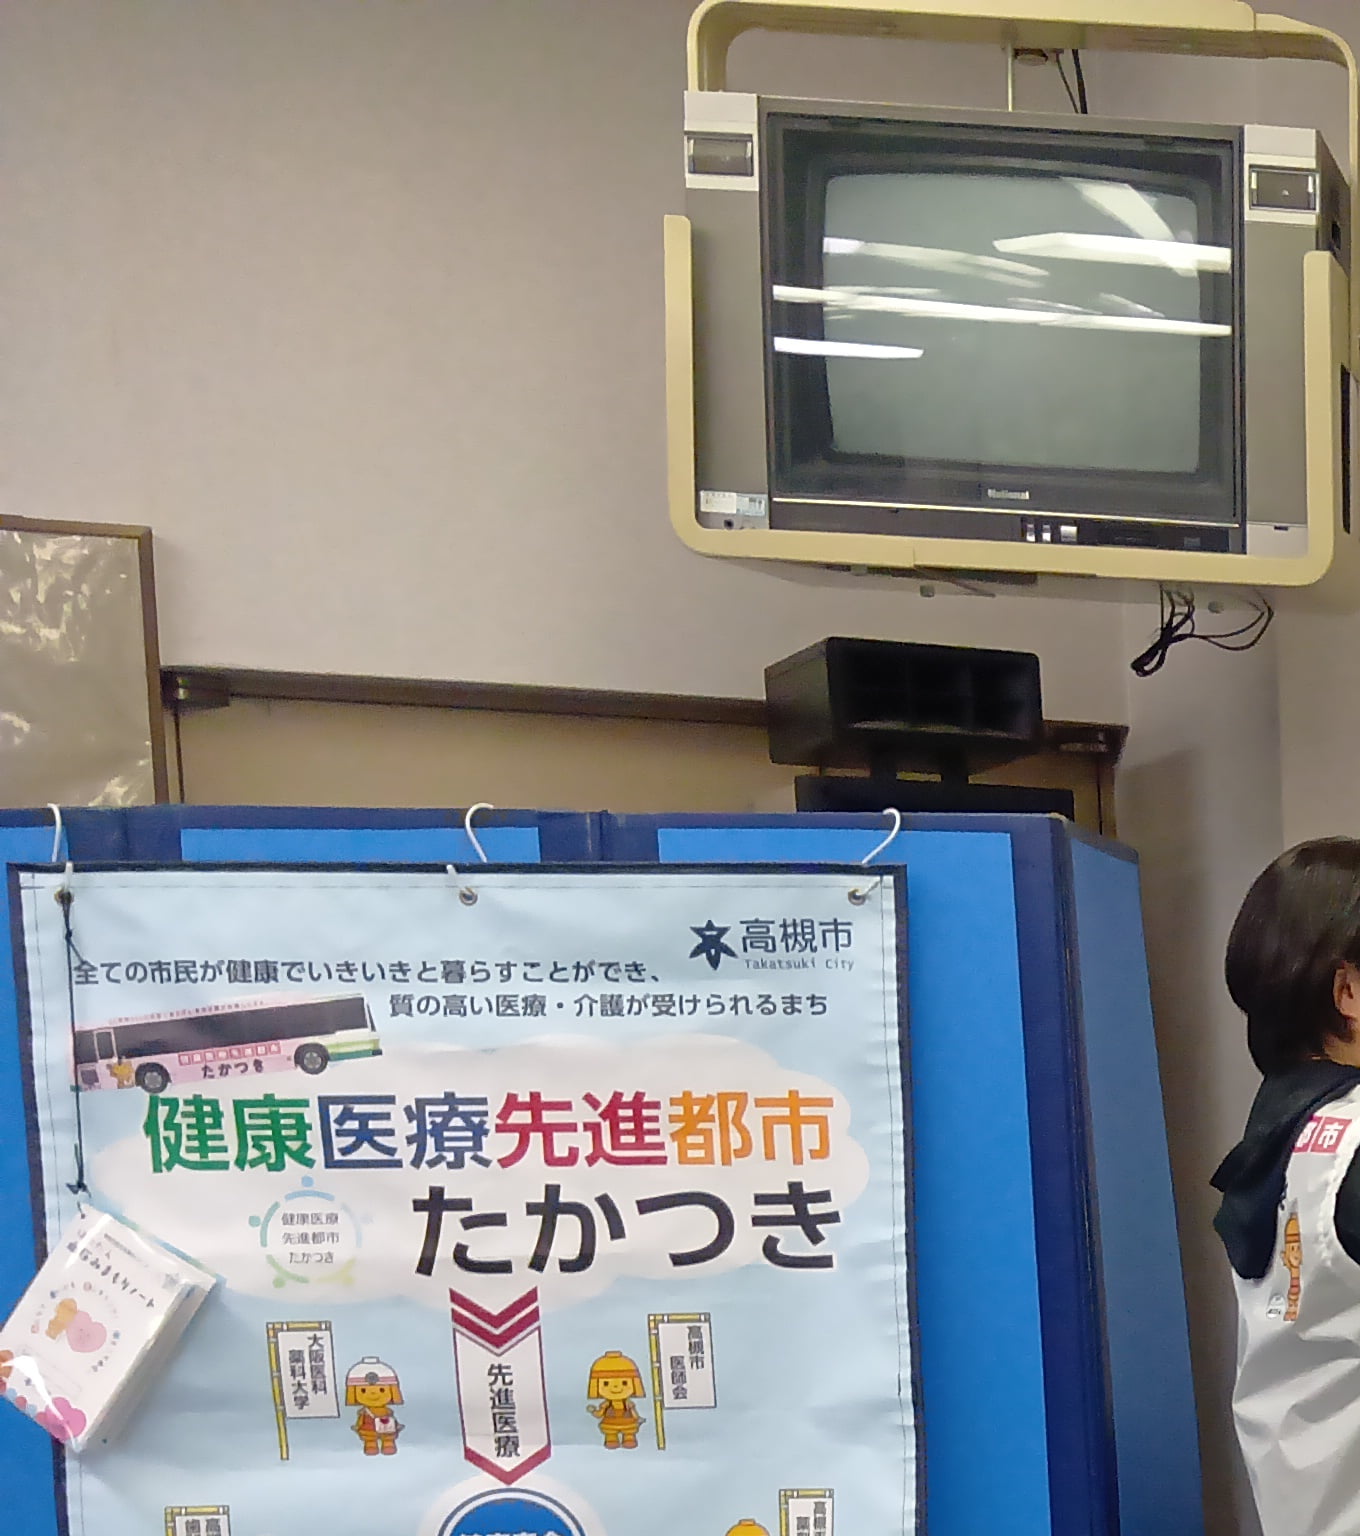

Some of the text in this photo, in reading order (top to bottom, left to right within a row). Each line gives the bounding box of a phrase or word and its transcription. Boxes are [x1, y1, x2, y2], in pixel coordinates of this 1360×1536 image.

[739, 918, 853, 954] 高槻市
[74, 960, 660, 985] 全ての市民が健康でいきいきと暮らすことができ、
[744, 958, 854, 972] Takatsuki City
[389, 993, 828, 1018] 質の高い医療・介護が受けられるまち
[202, 1058, 264, 1079] たかつき
[143, 1090, 835, 1173] 健康医療先進都市
[281, 1212, 339, 1226] 健康医療
[413, 1181, 841, 1277] たかつき
[282, 1231, 340, 1245] 先進都市
[289, 1251, 334, 1264] たかつき
[306, 1333, 328, 1395] 大阪医科
[686, 1324, 705, 1370] 高槻市
[288, 1349, 311, 1411] 薬科大学
[669, 1355, 688, 1401] 医師会
[486, 1363, 521, 1458] 先進医療
